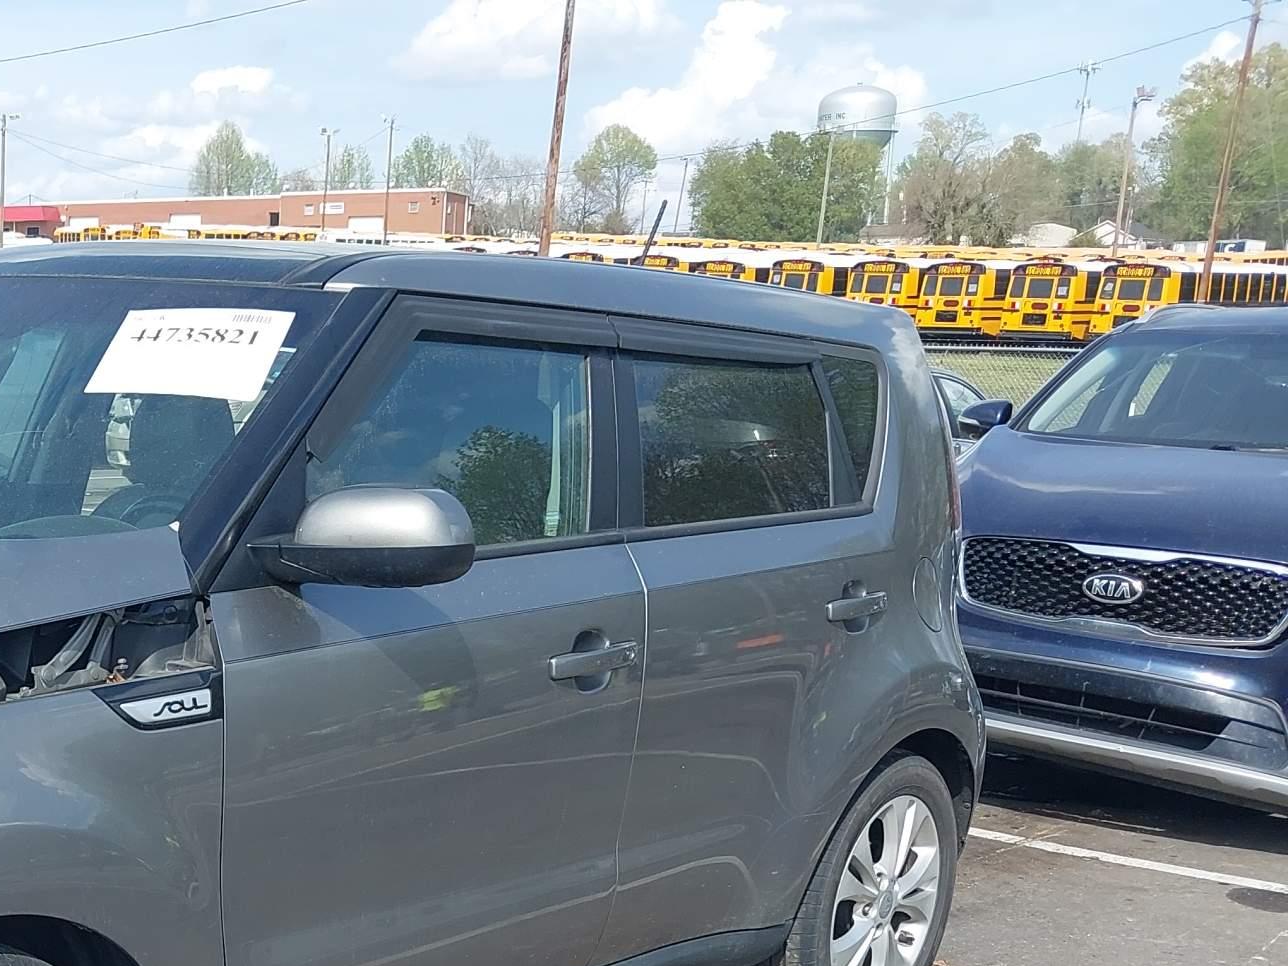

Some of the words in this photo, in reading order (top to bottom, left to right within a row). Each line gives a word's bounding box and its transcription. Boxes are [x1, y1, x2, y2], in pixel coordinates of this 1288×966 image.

[130, 327, 260, 345] 44735821
[1091, 578, 1131, 599] KIA
[153, 697, 208, 717] SOUL
